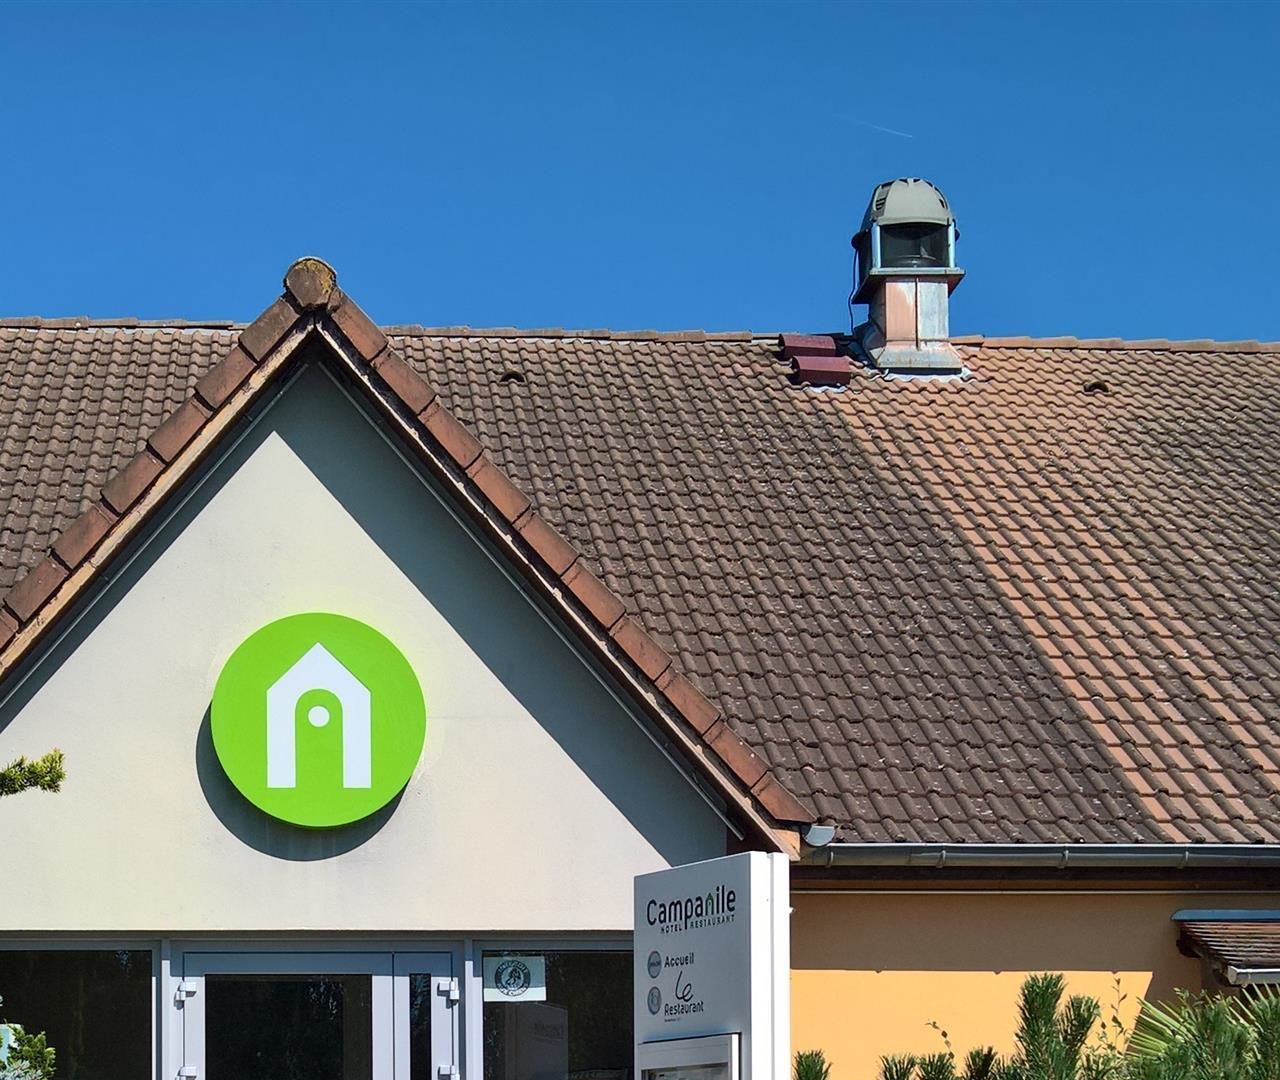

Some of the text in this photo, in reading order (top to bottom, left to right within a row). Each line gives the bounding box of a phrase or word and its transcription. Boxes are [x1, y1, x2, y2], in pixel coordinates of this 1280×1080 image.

[646, 884, 736, 931] Campanile
[660, 914, 735, 934] HOTEL RESTAURANT
[664, 952, 694, 968] Accueil
[664, 1001, 704, 1016] Restaurant
